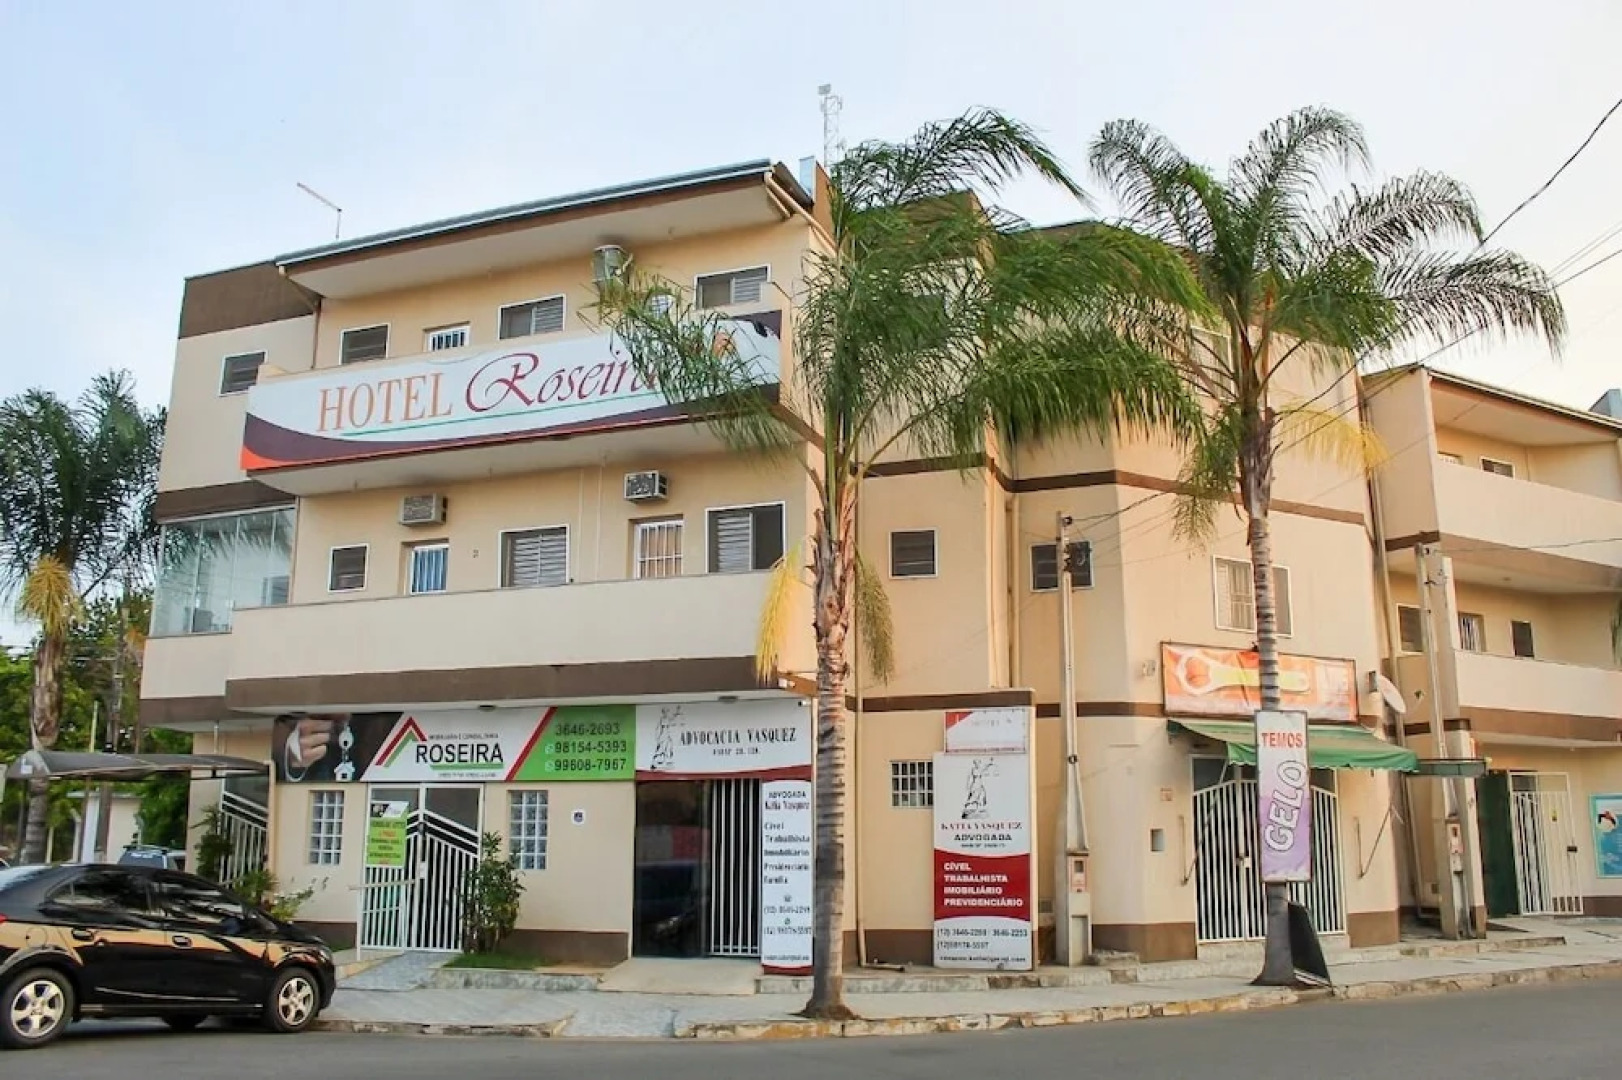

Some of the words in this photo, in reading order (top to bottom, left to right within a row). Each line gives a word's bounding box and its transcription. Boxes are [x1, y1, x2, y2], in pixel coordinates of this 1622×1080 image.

[316, 371, 454, 434] HOTEL
[555, 722, 621, 736] 3646-2693
[680, 729, 741, 746] ADVOCACIA
[747, 727, 797, 744] VASQUEZ
[1261, 732, 1304, 749] TEMOS
[416, 743, 504, 763] ROSEIRA
[554, 740, 627, 753] 98154-5393
[554, 758, 627, 771] 99608-7967
[769, 790, 807, 799] ADVOGADA
[1263, 759, 1308, 852] GELO
[953, 833, 1013, 842] ADVOGADA
[943, 874, 1009, 883] TRABALHISTA
[943, 886, 1003, 895] IMOBILIÁRIO
[943, 897, 1024, 907] PREVIDENCIÁRIO
